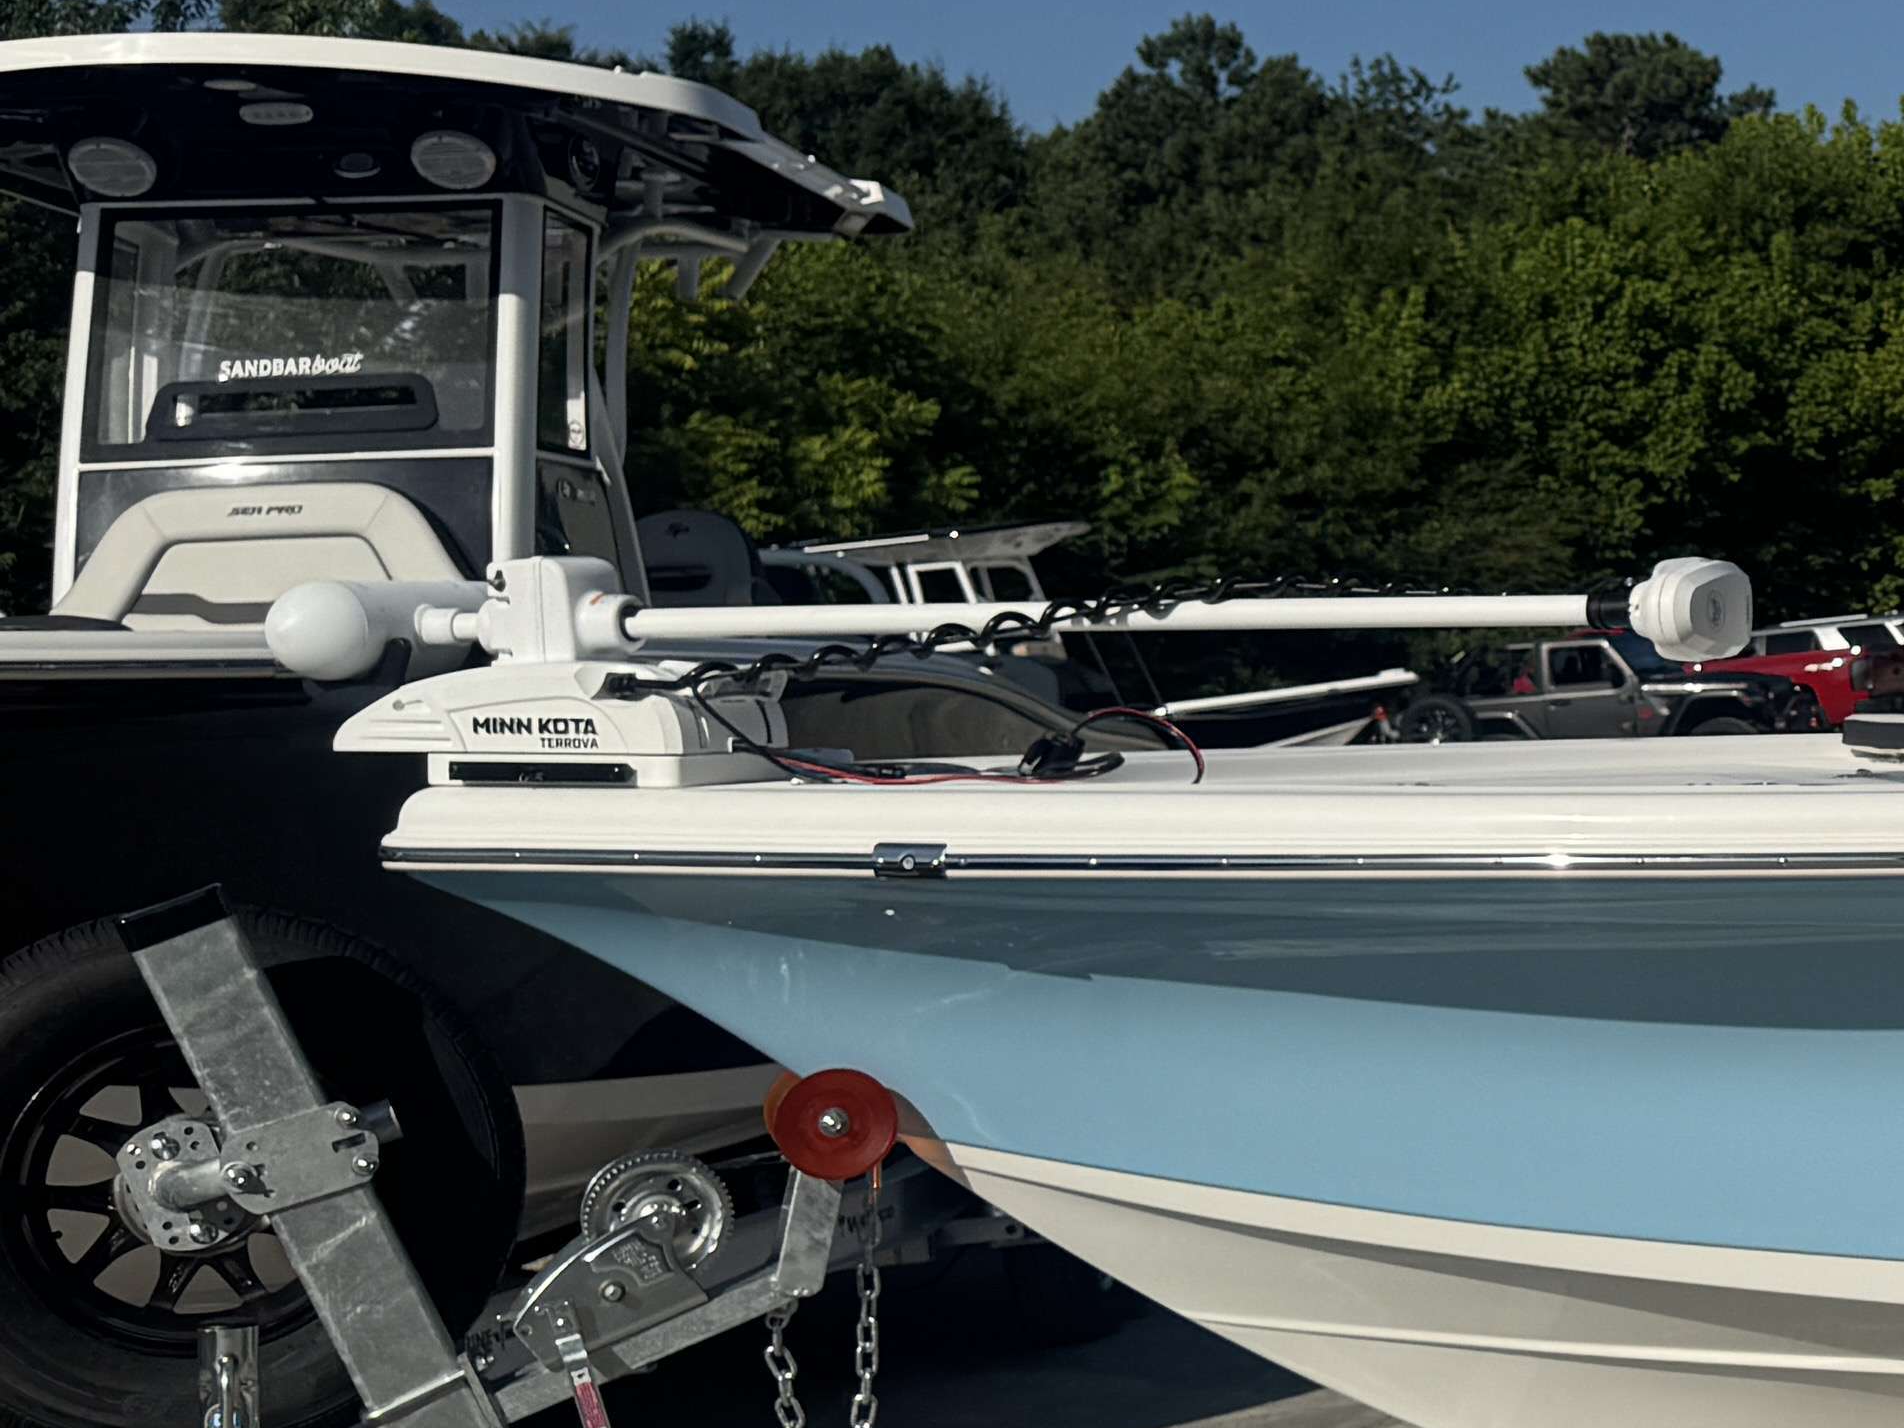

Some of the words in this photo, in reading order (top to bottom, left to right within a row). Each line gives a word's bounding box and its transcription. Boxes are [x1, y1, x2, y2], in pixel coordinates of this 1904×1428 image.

[472, 716, 532, 736] MINN
[537, 717, 599, 736] KOTA
[540, 737, 599, 749] TERROVA
